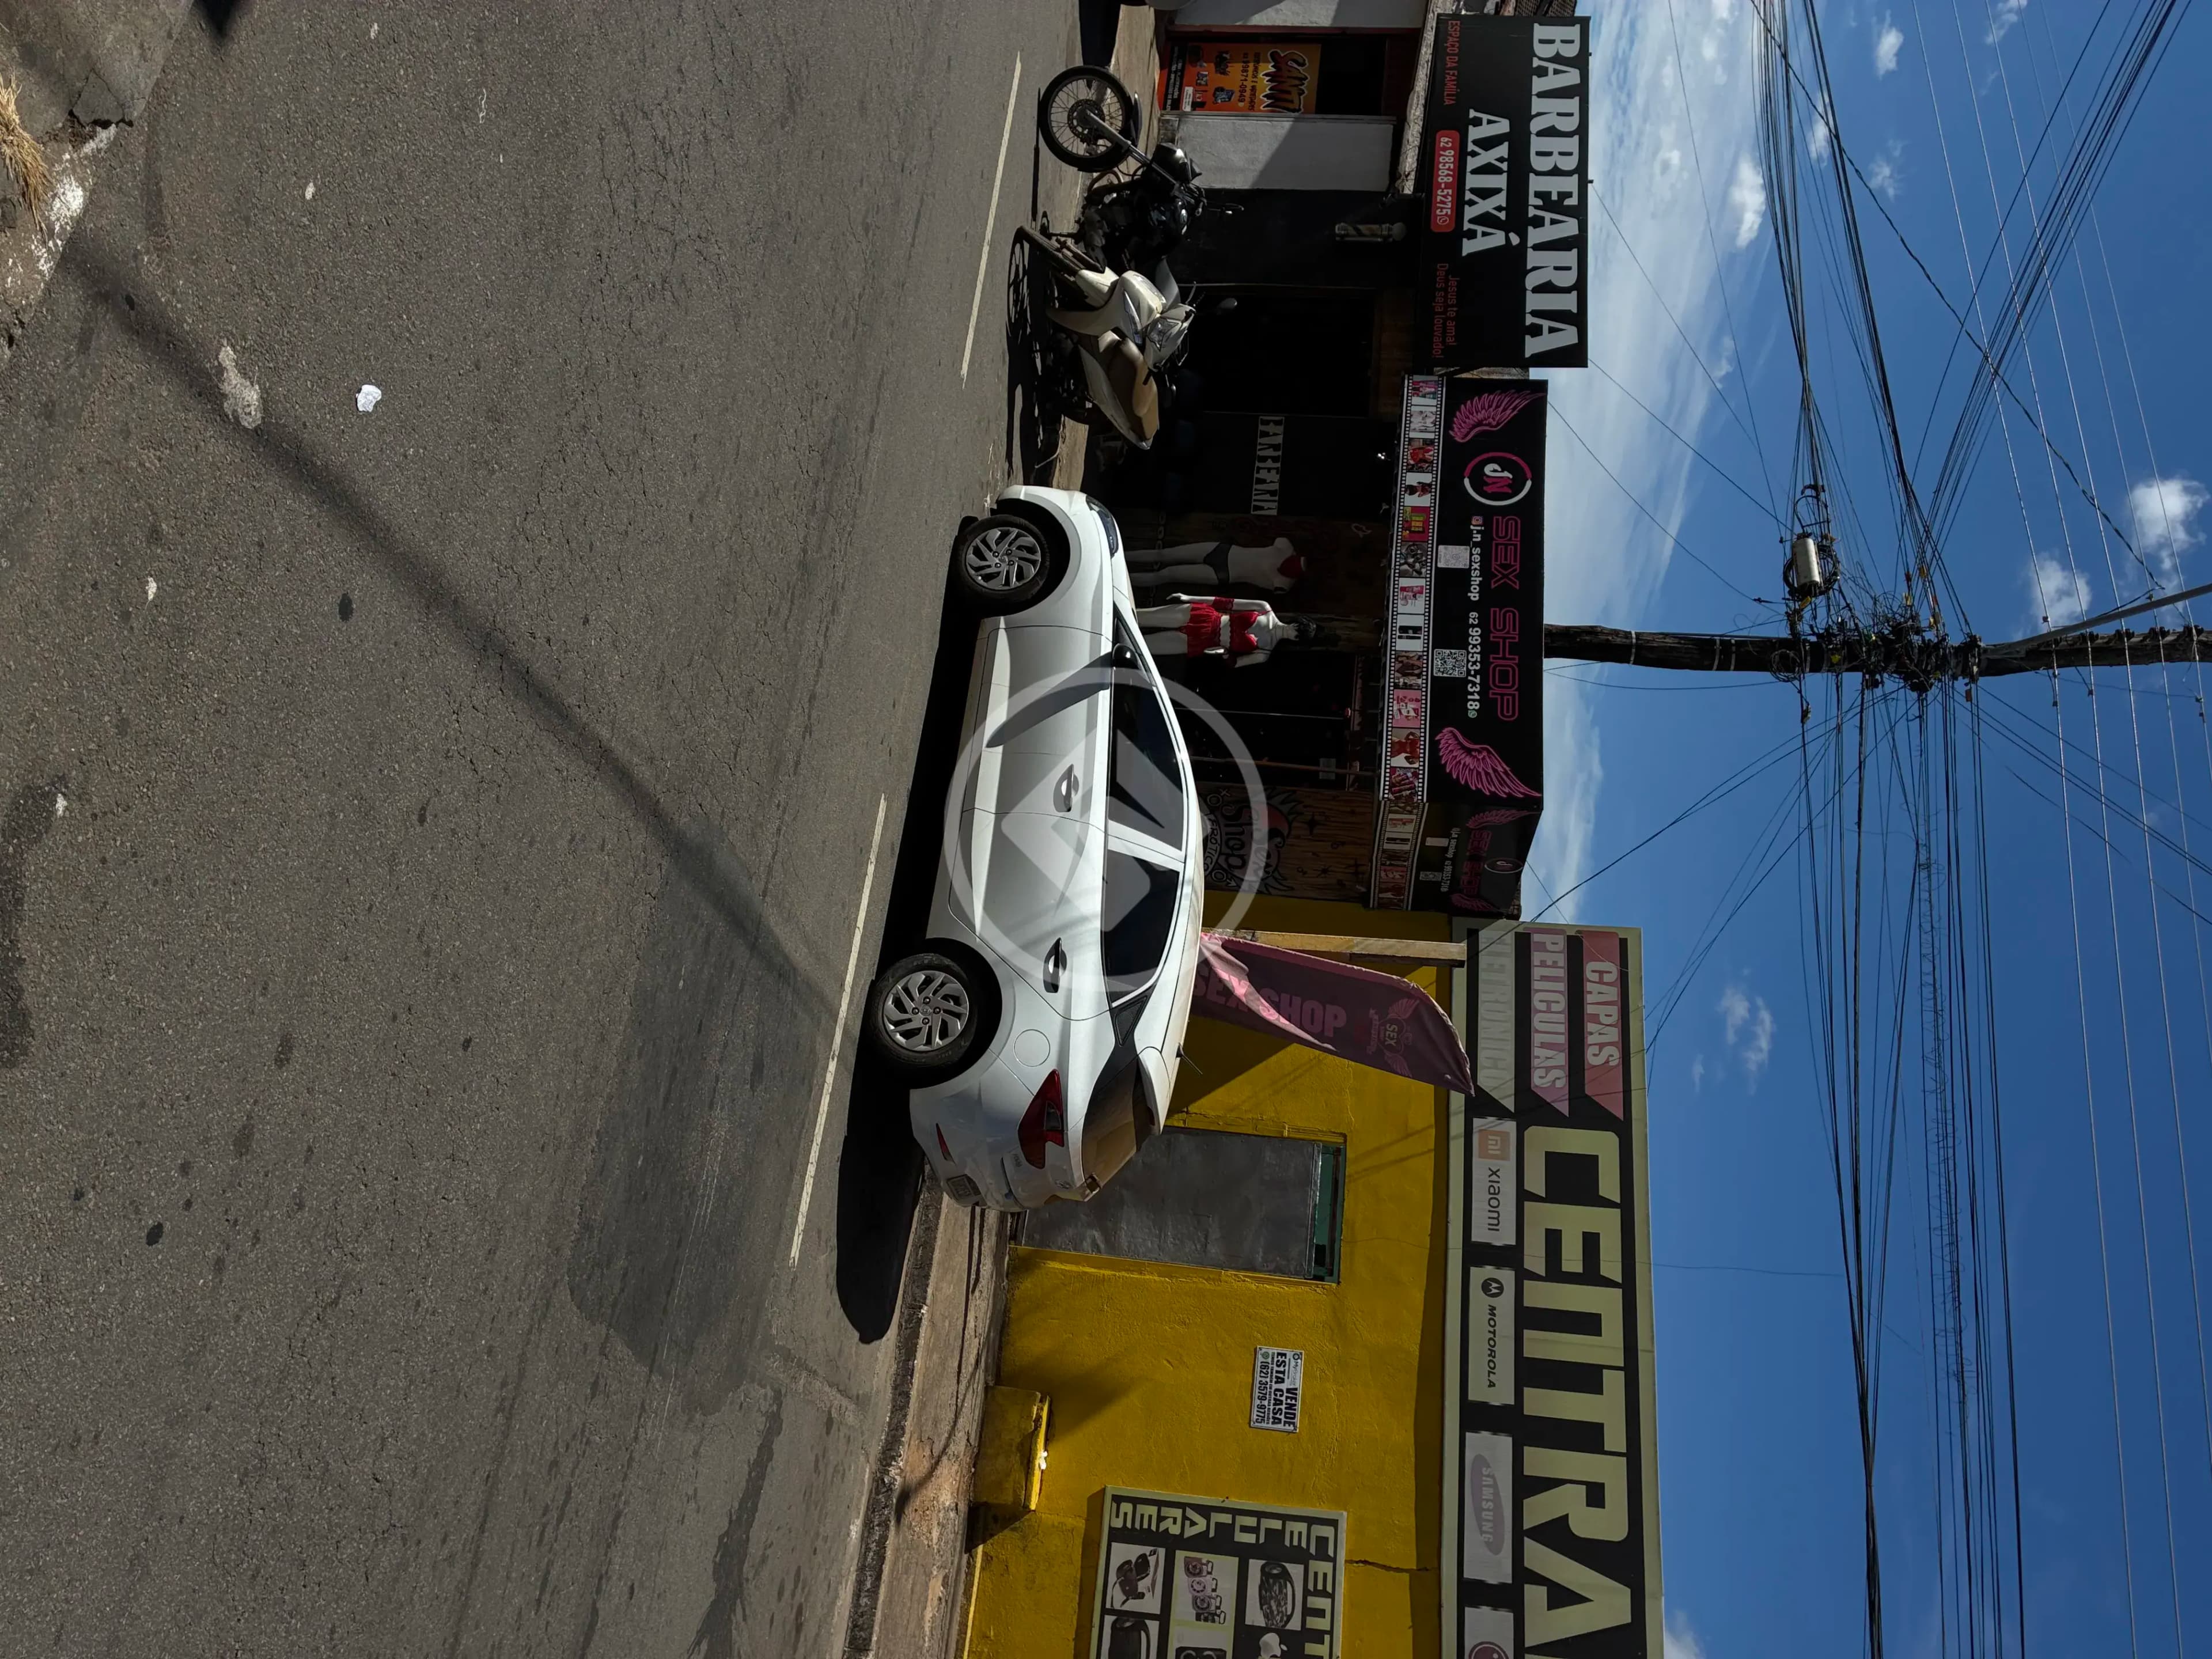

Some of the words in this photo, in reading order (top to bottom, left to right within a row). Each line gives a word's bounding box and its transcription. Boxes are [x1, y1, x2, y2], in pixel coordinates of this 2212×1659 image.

[1445, 20, 1460, 55] ESPAÇO
[1445, 56, 1459, 68] DA
[1442, 70, 1460, 106] FAMÍLIA
[1439, 137, 1453, 148] 62
[1435, 149, 1455, 215] 98568-5275
[1462, 109, 1520, 256] AXIXÁ
[1524, 23, 1581, 358] BARBEARIA
[1435, 263, 1449, 288] Deus
[1447, 275, 1460, 304] Jesus
[1432, 291, 1446, 312] seja
[1447, 307, 1459, 317] te
[1431, 315, 1446, 358] louvado!
[1445, 320, 1457, 346] ama!
[1252, 418, 1284, 513] BARBEARIA
[1467, 525, 1484, 601] j.n_sexshop
[1491, 516, 1520, 589] SEX
[1468, 612, 1479, 624] 62
[1467, 627, 1482, 710] 99353-7318
[1489, 608, 1519, 721] SHOP
[1465, 830, 1493, 857] SEX
[1460, 861, 1484, 895] SHOP
[1532, 933, 1566, 1088] PELICULAS
[1585, 961, 1619, 1066] CAPAS
[1385, 1024, 1398, 1047] SEX
[1487, 1304, 1498, 1388] MOTOROLA
[1259, 1361, 1270, 1378] (62)
[1274, 1352, 1287, 1384] ESTA
[1255, 1380, 1268, 1424] 3579-9775
[1271, 1388, 1284, 1425] CASA
[1283, 1387, 1298, 1427] VENDE
[1524, 1126, 1631, 1659] CENTRA
[1480, 1467, 1494, 1543] SAMSUNG
